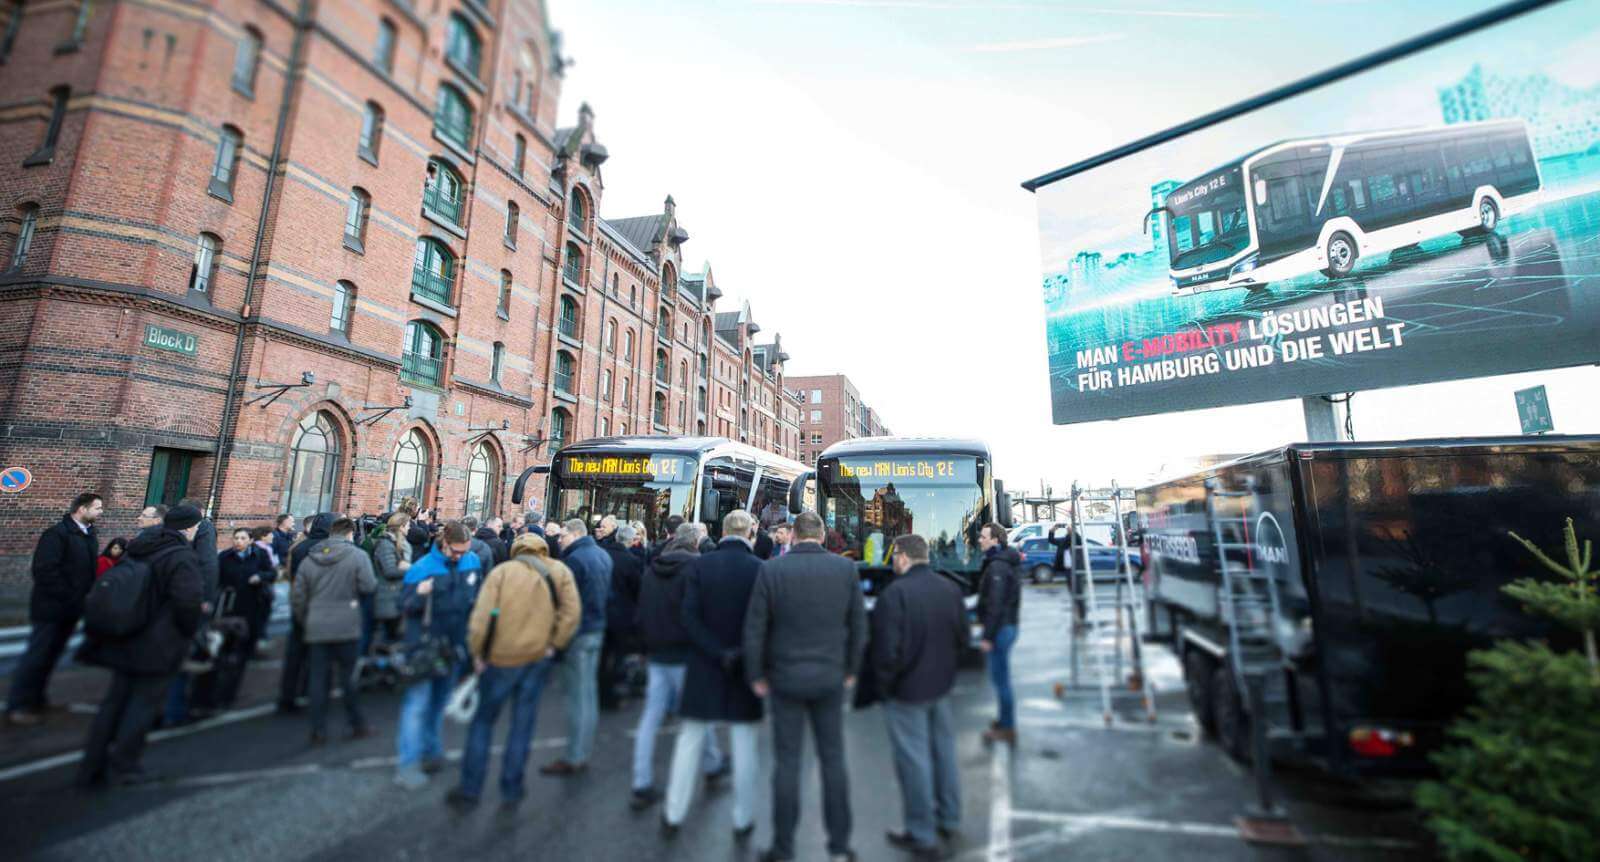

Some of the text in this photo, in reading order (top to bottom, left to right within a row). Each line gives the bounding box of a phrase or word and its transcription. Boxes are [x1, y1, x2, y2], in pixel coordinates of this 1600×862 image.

[1194, 184, 1209, 197] City
[1209, 178, 1219, 190] 12
[1219, 175, 1226, 186] E
[1192, 272, 1209, 281] MAN
[148, 327, 195, 352] Block D
[1076, 296, 1385, 369] MAN E-MOBILITY LÖSUNGEN
[1078, 322, 1405, 392] FÜR HAMBURG UND DIE WELT
[570, 457, 584, 473] The
[585, 461, 600, 473] new
[602, 458, 619, 473] MAN
[620, 458, 640, 473] Lion's
[642, 458, 658, 476] City
[671, 459, 678, 473] E
[839, 462, 854, 477] The
[856, 466, 872, 477] new
[874, 462, 891, 477] MAN
[892, 462, 915, 477] Lion's
[917, 462, 934, 478] City
[948, 462, 954, 476] E
[1256, 545, 1288, 563] MAN
